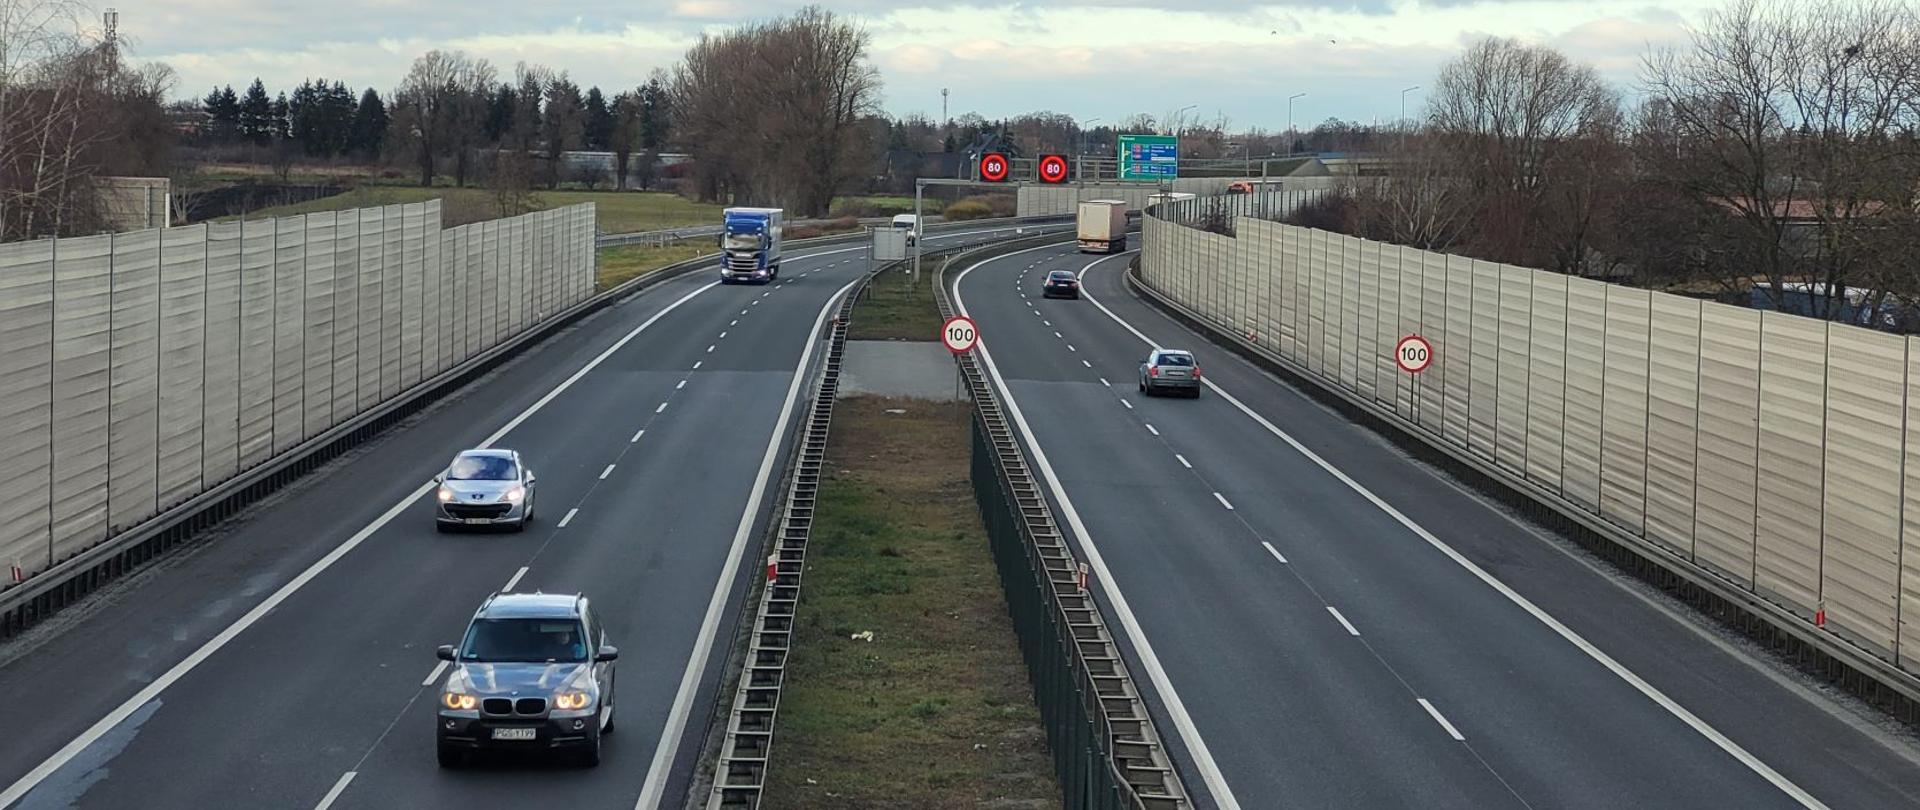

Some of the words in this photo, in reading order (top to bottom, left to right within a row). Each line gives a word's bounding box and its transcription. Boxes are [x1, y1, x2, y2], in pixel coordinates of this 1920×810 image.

[987, 162, 1001, 172] 80
[1046, 164, 1060, 174] 80
[947, 327, 974, 342] 100
[1401, 347, 1427, 361] 100
